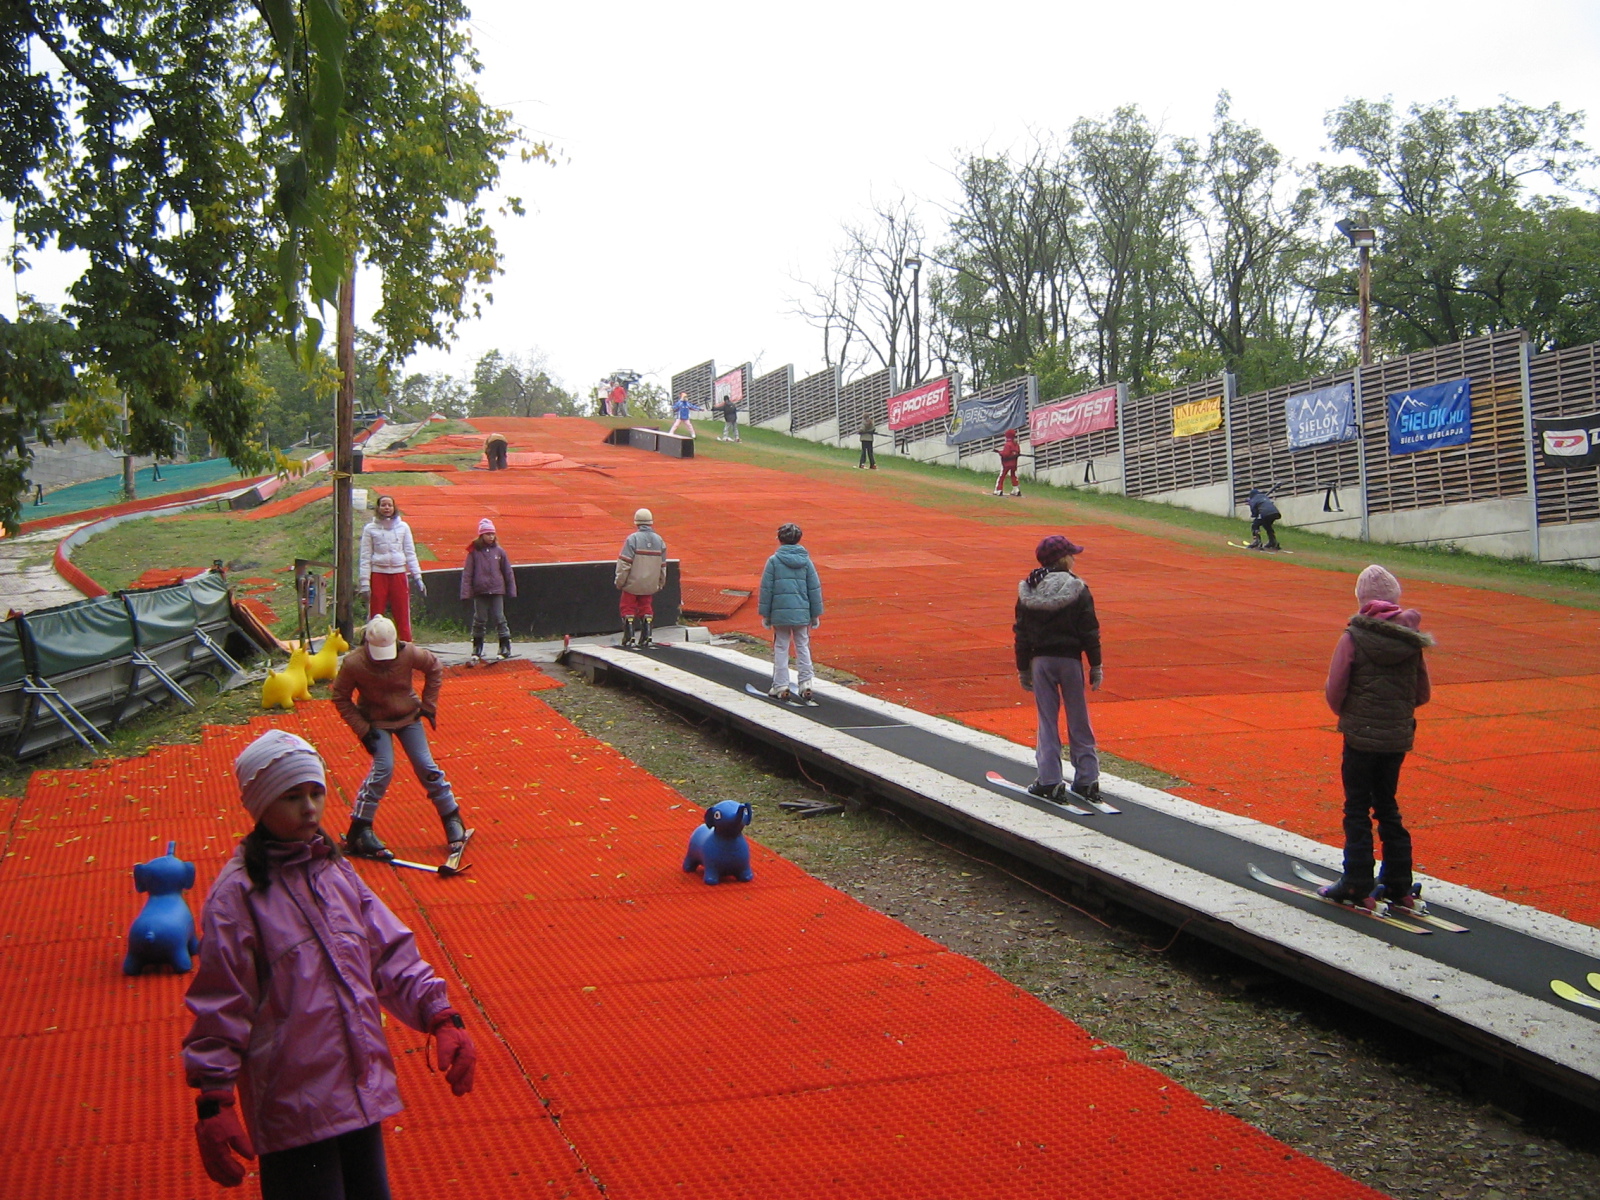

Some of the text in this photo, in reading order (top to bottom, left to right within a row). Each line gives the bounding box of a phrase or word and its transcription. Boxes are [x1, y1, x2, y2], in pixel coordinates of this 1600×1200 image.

[902, 387, 946, 414] PROTEST
[1050, 396, 1113, 426] PROTEST
[1175, 399, 1220, 420] UNITRAVEL
[1401, 405, 1464, 433] SÍELŐK.HU
[1427, 428, 1464, 440] WEBLAPJA
